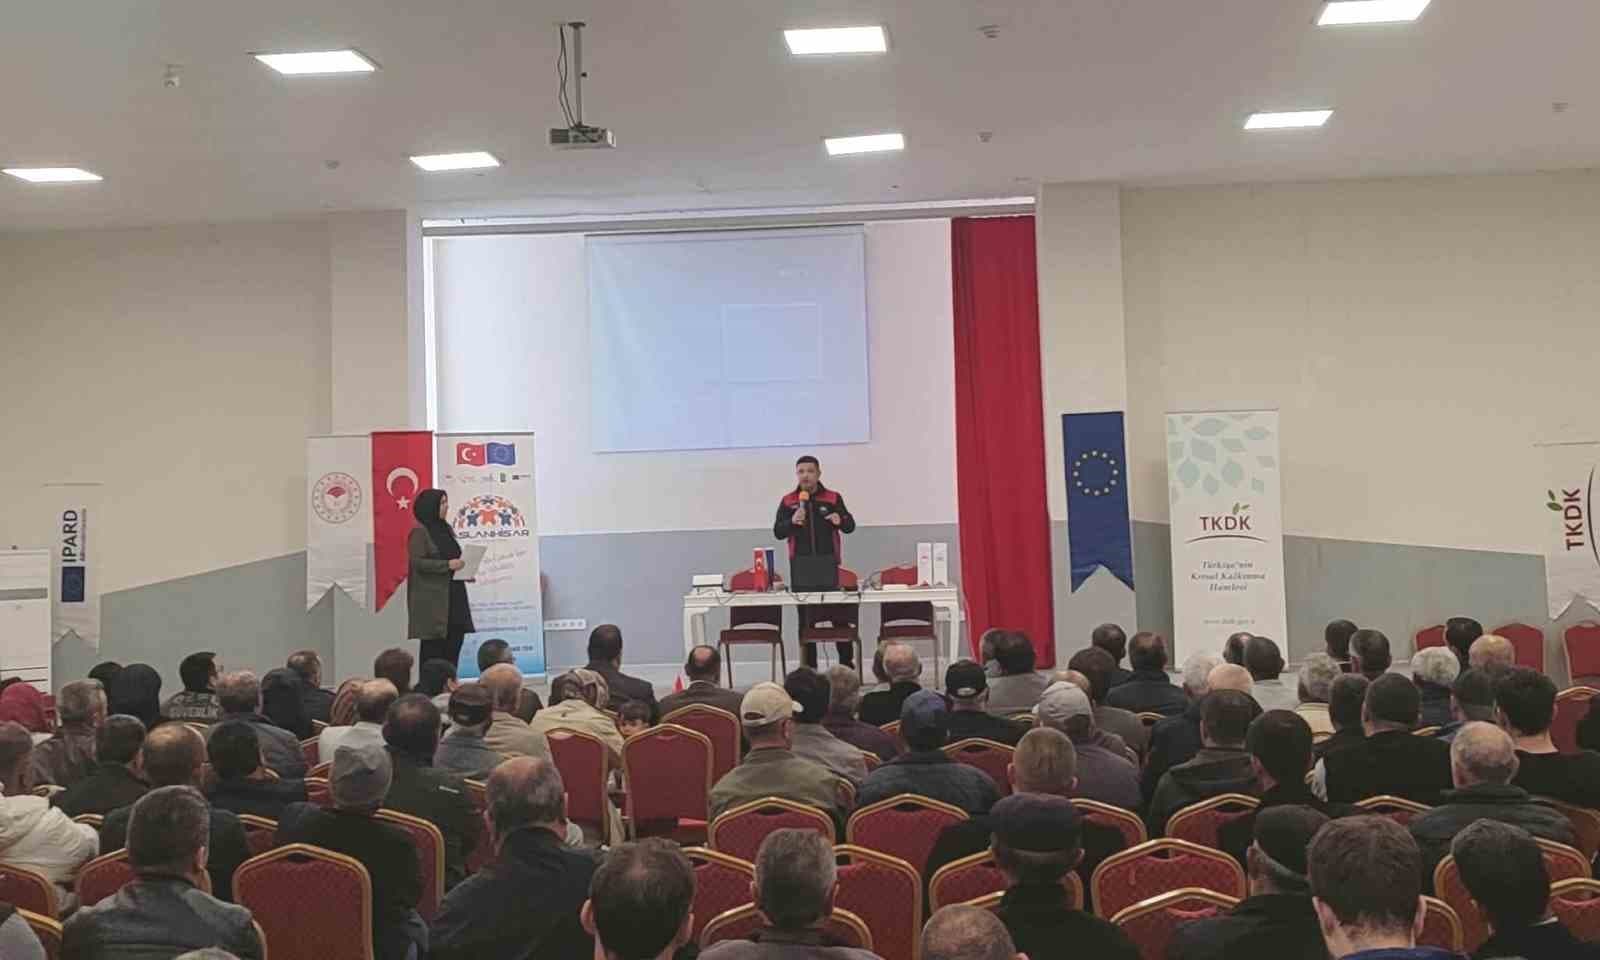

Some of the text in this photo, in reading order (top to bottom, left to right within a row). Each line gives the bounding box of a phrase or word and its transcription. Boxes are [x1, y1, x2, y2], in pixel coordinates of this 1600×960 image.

[62, 509, 79, 563] IPARD
[1199, 515, 1252, 531] TKDK
[1561, 487, 1585, 551] TKDK
